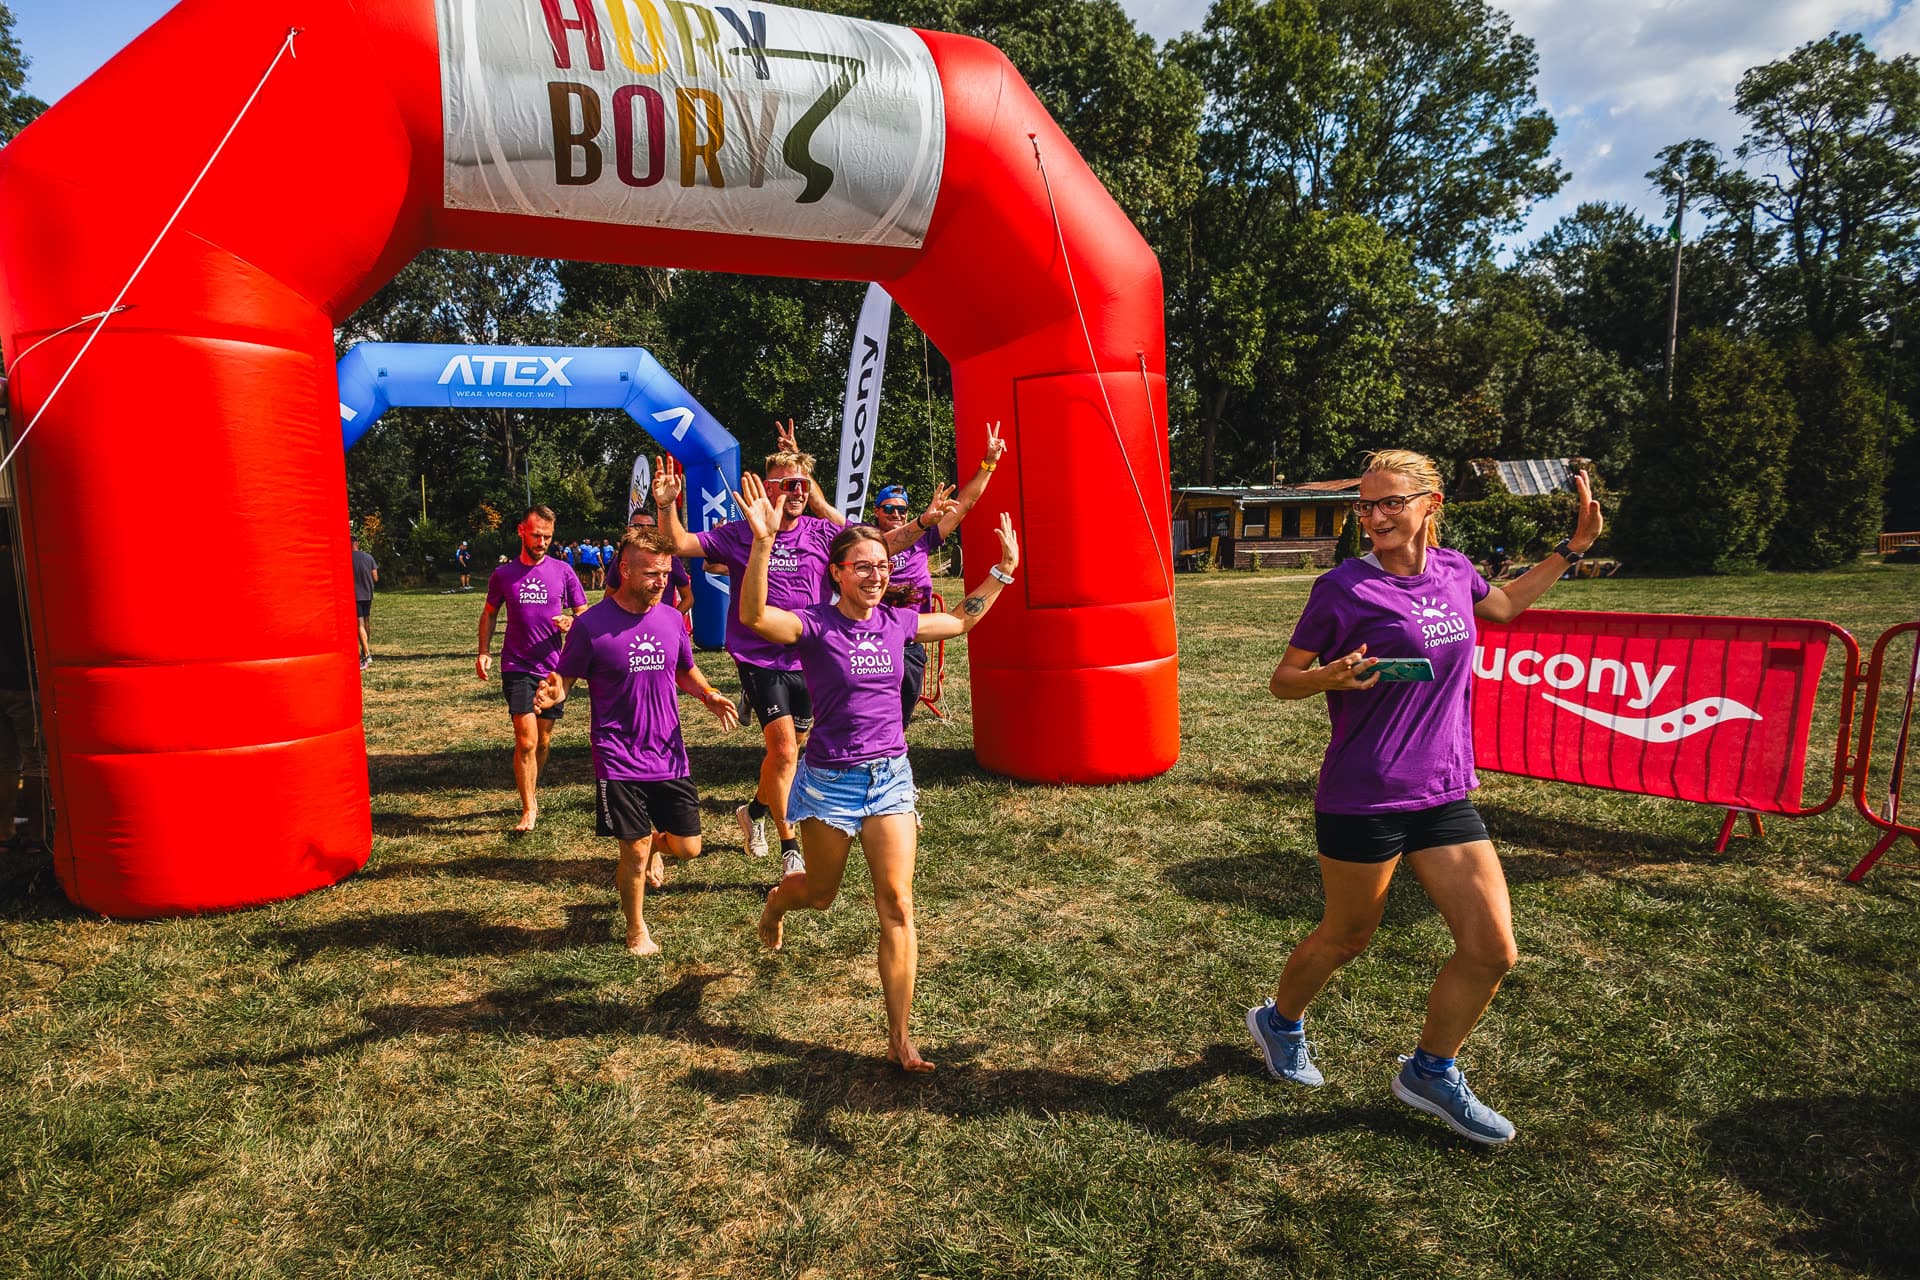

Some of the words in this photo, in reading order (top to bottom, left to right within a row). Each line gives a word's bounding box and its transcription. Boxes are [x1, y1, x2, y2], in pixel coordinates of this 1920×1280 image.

[540, 0, 770, 80] HORY
[547, 82, 780, 188] BORY
[437, 355, 574, 386] ATEX
[519, 592, 547, 600] SPOLU
[1421, 617, 1466, 639] SPOLU
[1424, 640, 1430, 649] S
[1430, 631, 1469, 647] ODVAHOU
[629, 654, 665, 667] SPOLU
[850, 654, 891, 667] SPOLU
[850, 667, 856, 675] S
[856, 666, 894, 675] ODVAHOU
[1472, 645, 1676, 709] ucony
